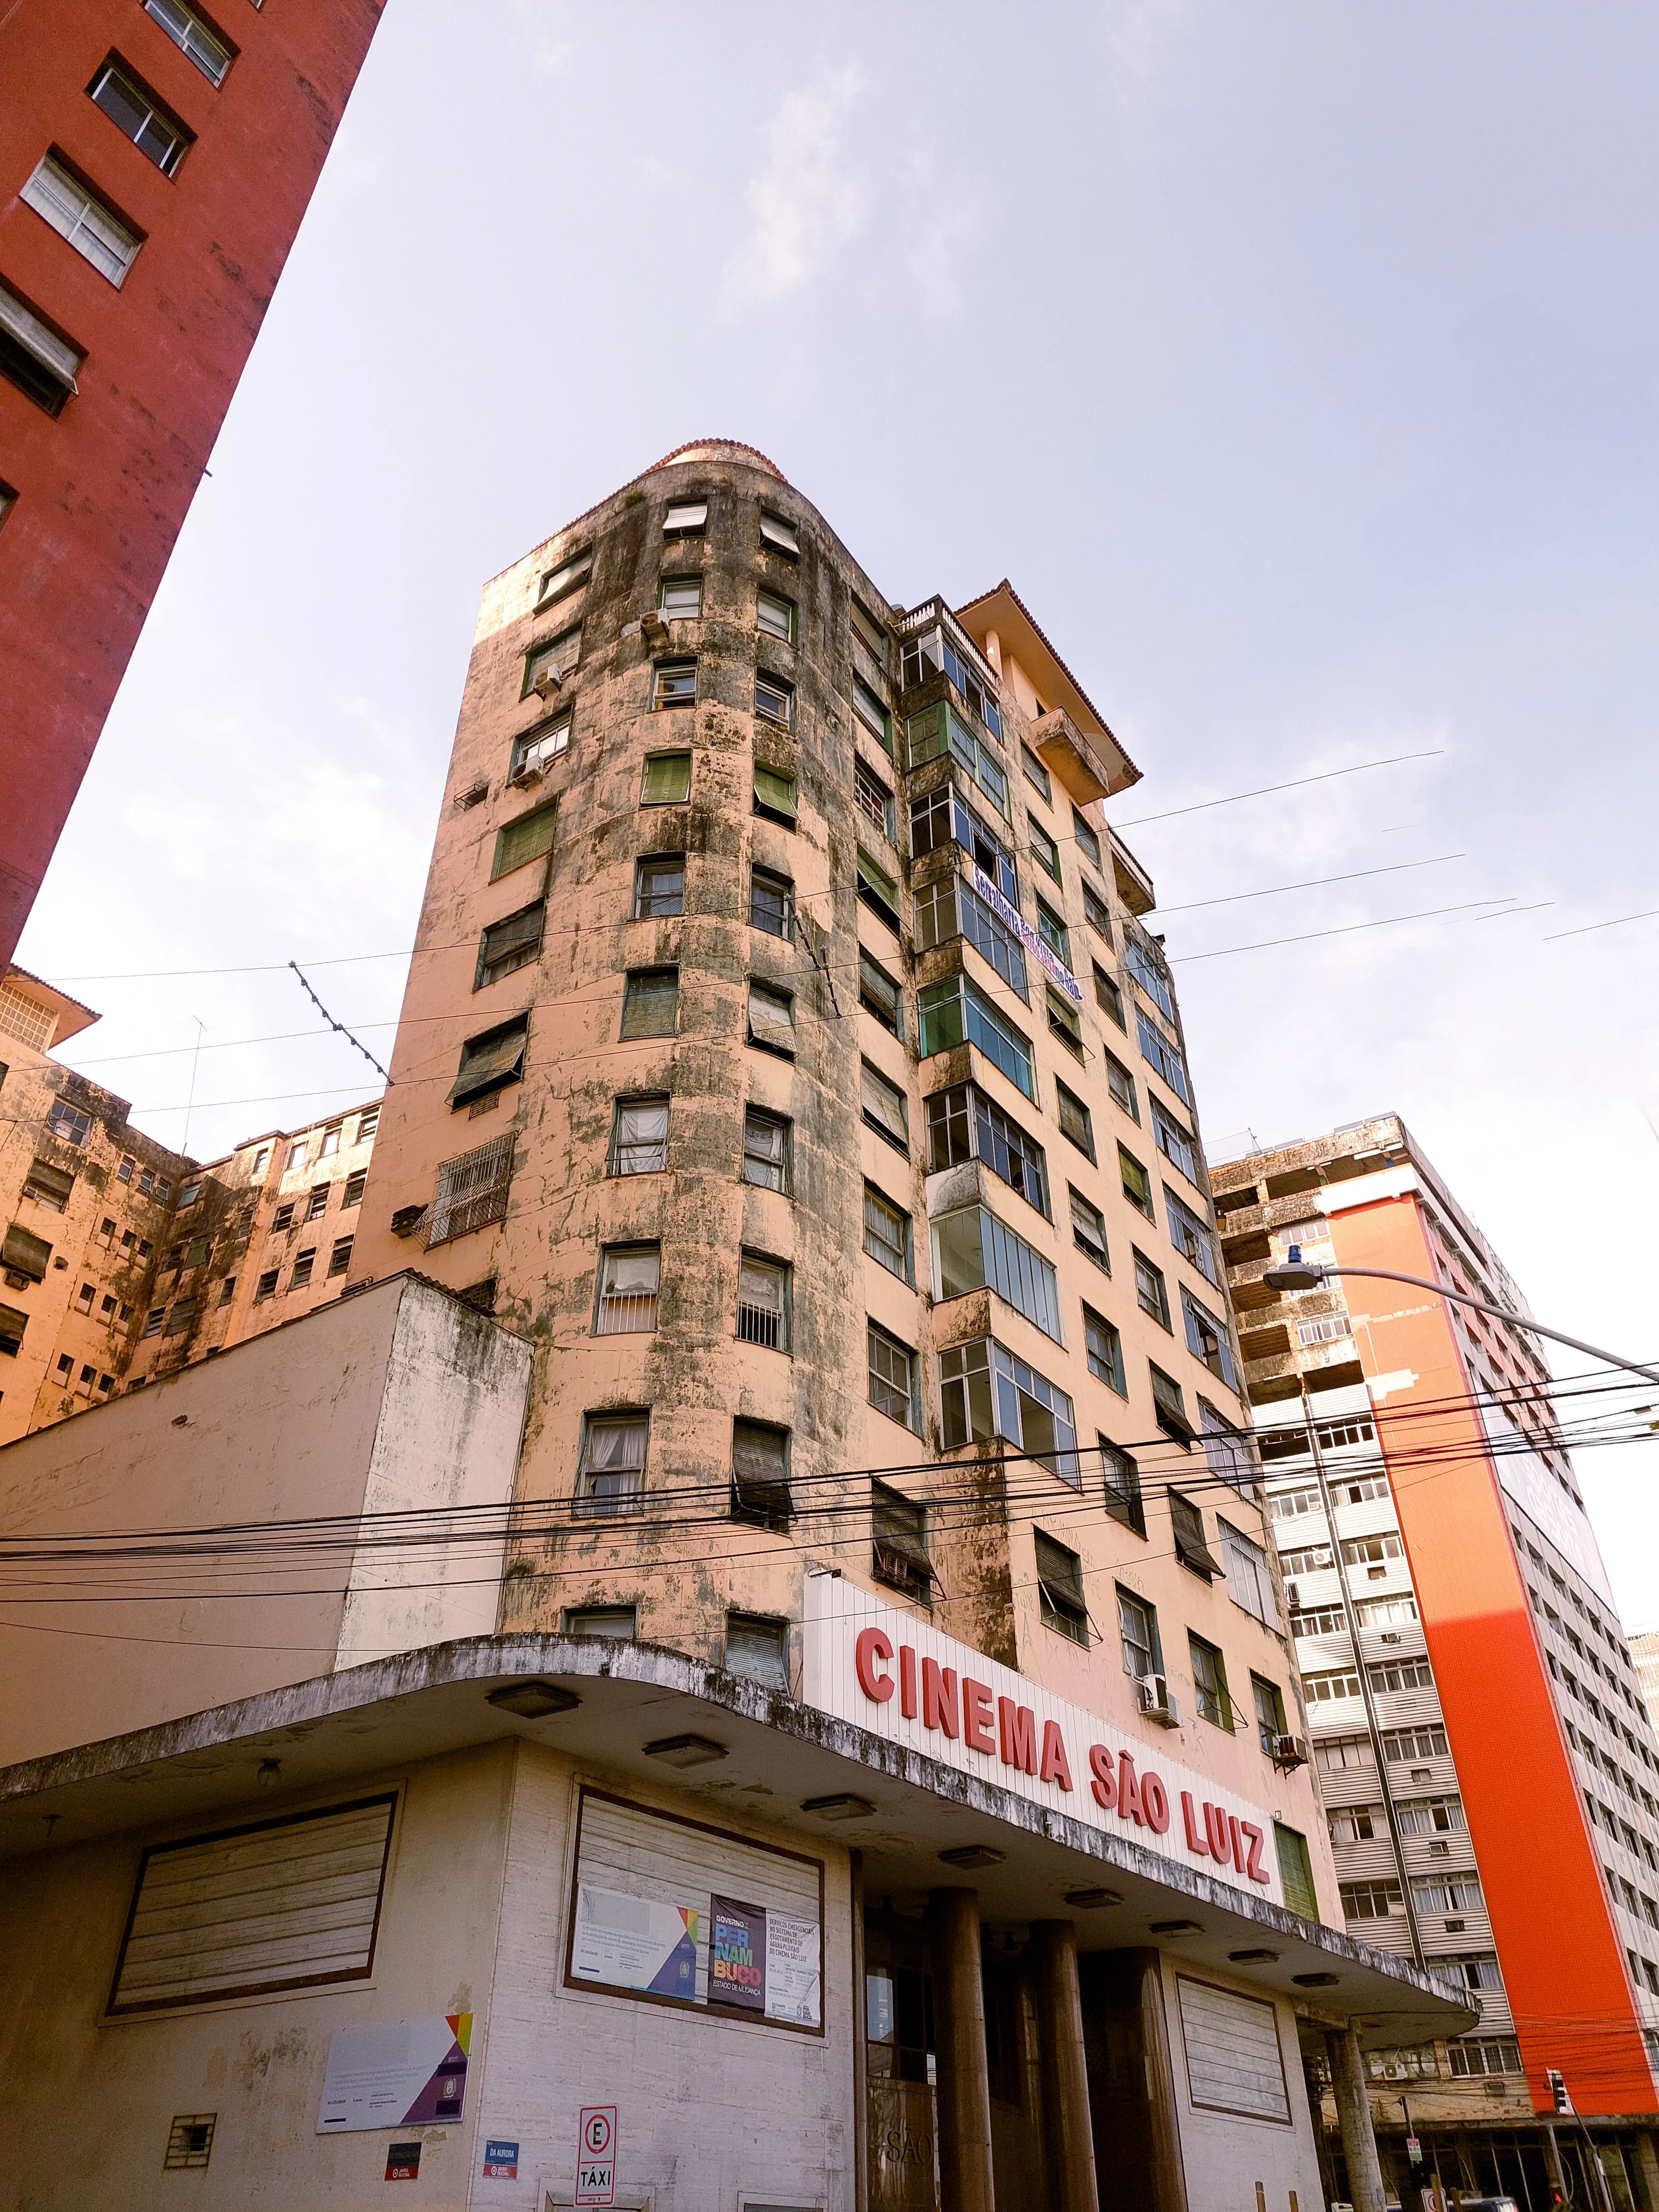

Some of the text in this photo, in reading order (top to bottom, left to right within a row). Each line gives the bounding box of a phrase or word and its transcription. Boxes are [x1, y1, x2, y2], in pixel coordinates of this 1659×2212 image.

[975, 865, 1020, 937] Serralharia
[1036, 934, 1055, 964] Vista
[855, 1627, 1271, 1884] CINEMA SÃO LUIZ
[716, 1915, 744, 1928] GOVERNO
[770, 1919, 787, 1928] SERVIÇOS
[715, 1923, 749, 1948] PER
[770, 1933, 797, 1945] ESGOTAMENTO
[776, 1927, 792, 1937] SISTEMA
[714, 1941, 753, 1967] NAM
[770, 1939, 800, 1953] ÁGUAS PLUVIAIS
[775, 1949, 790, 1958] CINEMA
[714, 1959, 762, 1986] BUCO
[713, 1980, 731, 1990] ESTADO
[732, 1983, 738, 1991] DE
[738, 1985, 761, 1996] MUDANÇA
[593, 2123, 603, 2145] E
[490, 2148, 514, 2158] DA AURORA
[581, 2166, 611, 2187] TÁXI
